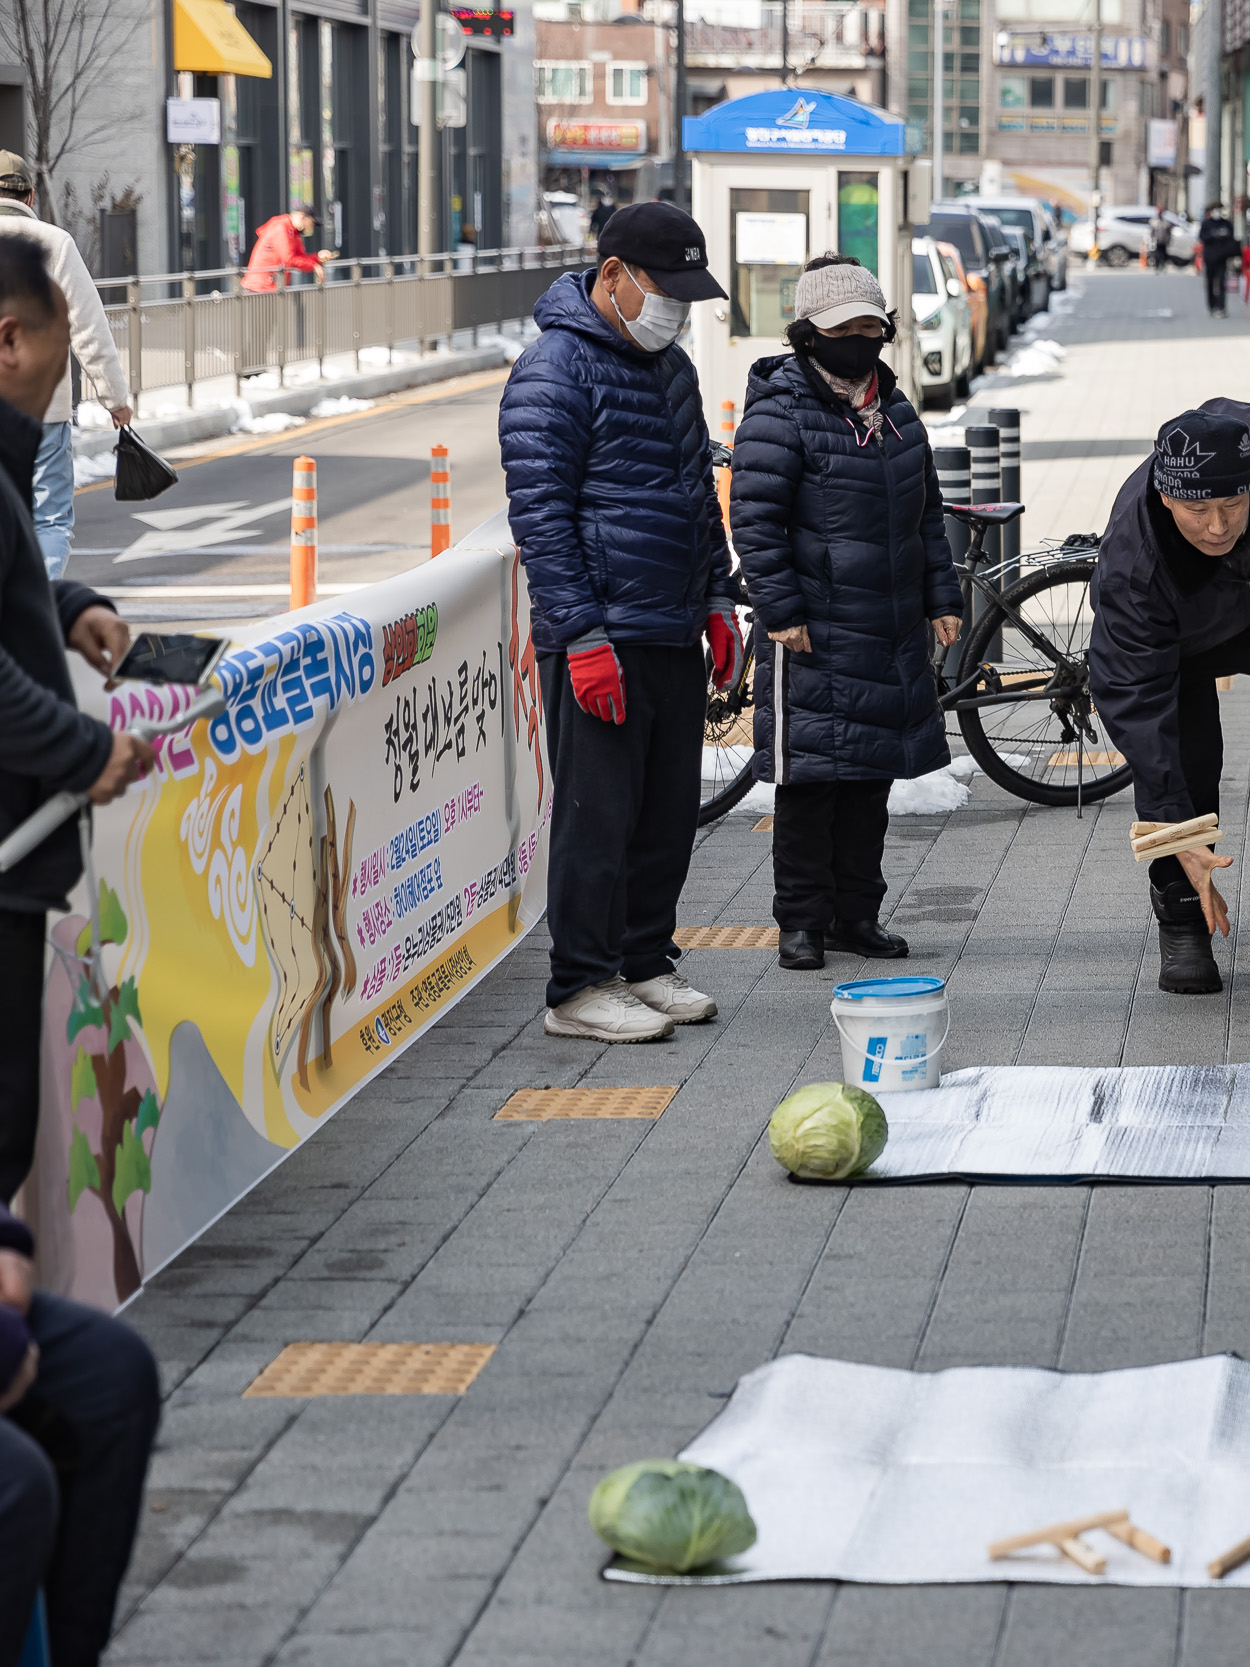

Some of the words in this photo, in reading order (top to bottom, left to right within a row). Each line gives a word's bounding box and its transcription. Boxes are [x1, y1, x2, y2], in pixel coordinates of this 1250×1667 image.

[1164, 455, 1195, 468] HAHU
[1162, 484, 1212, 499] CLASSIC
[444, 797, 456, 834] 오후
[362, 896, 393, 945] 행사장소
